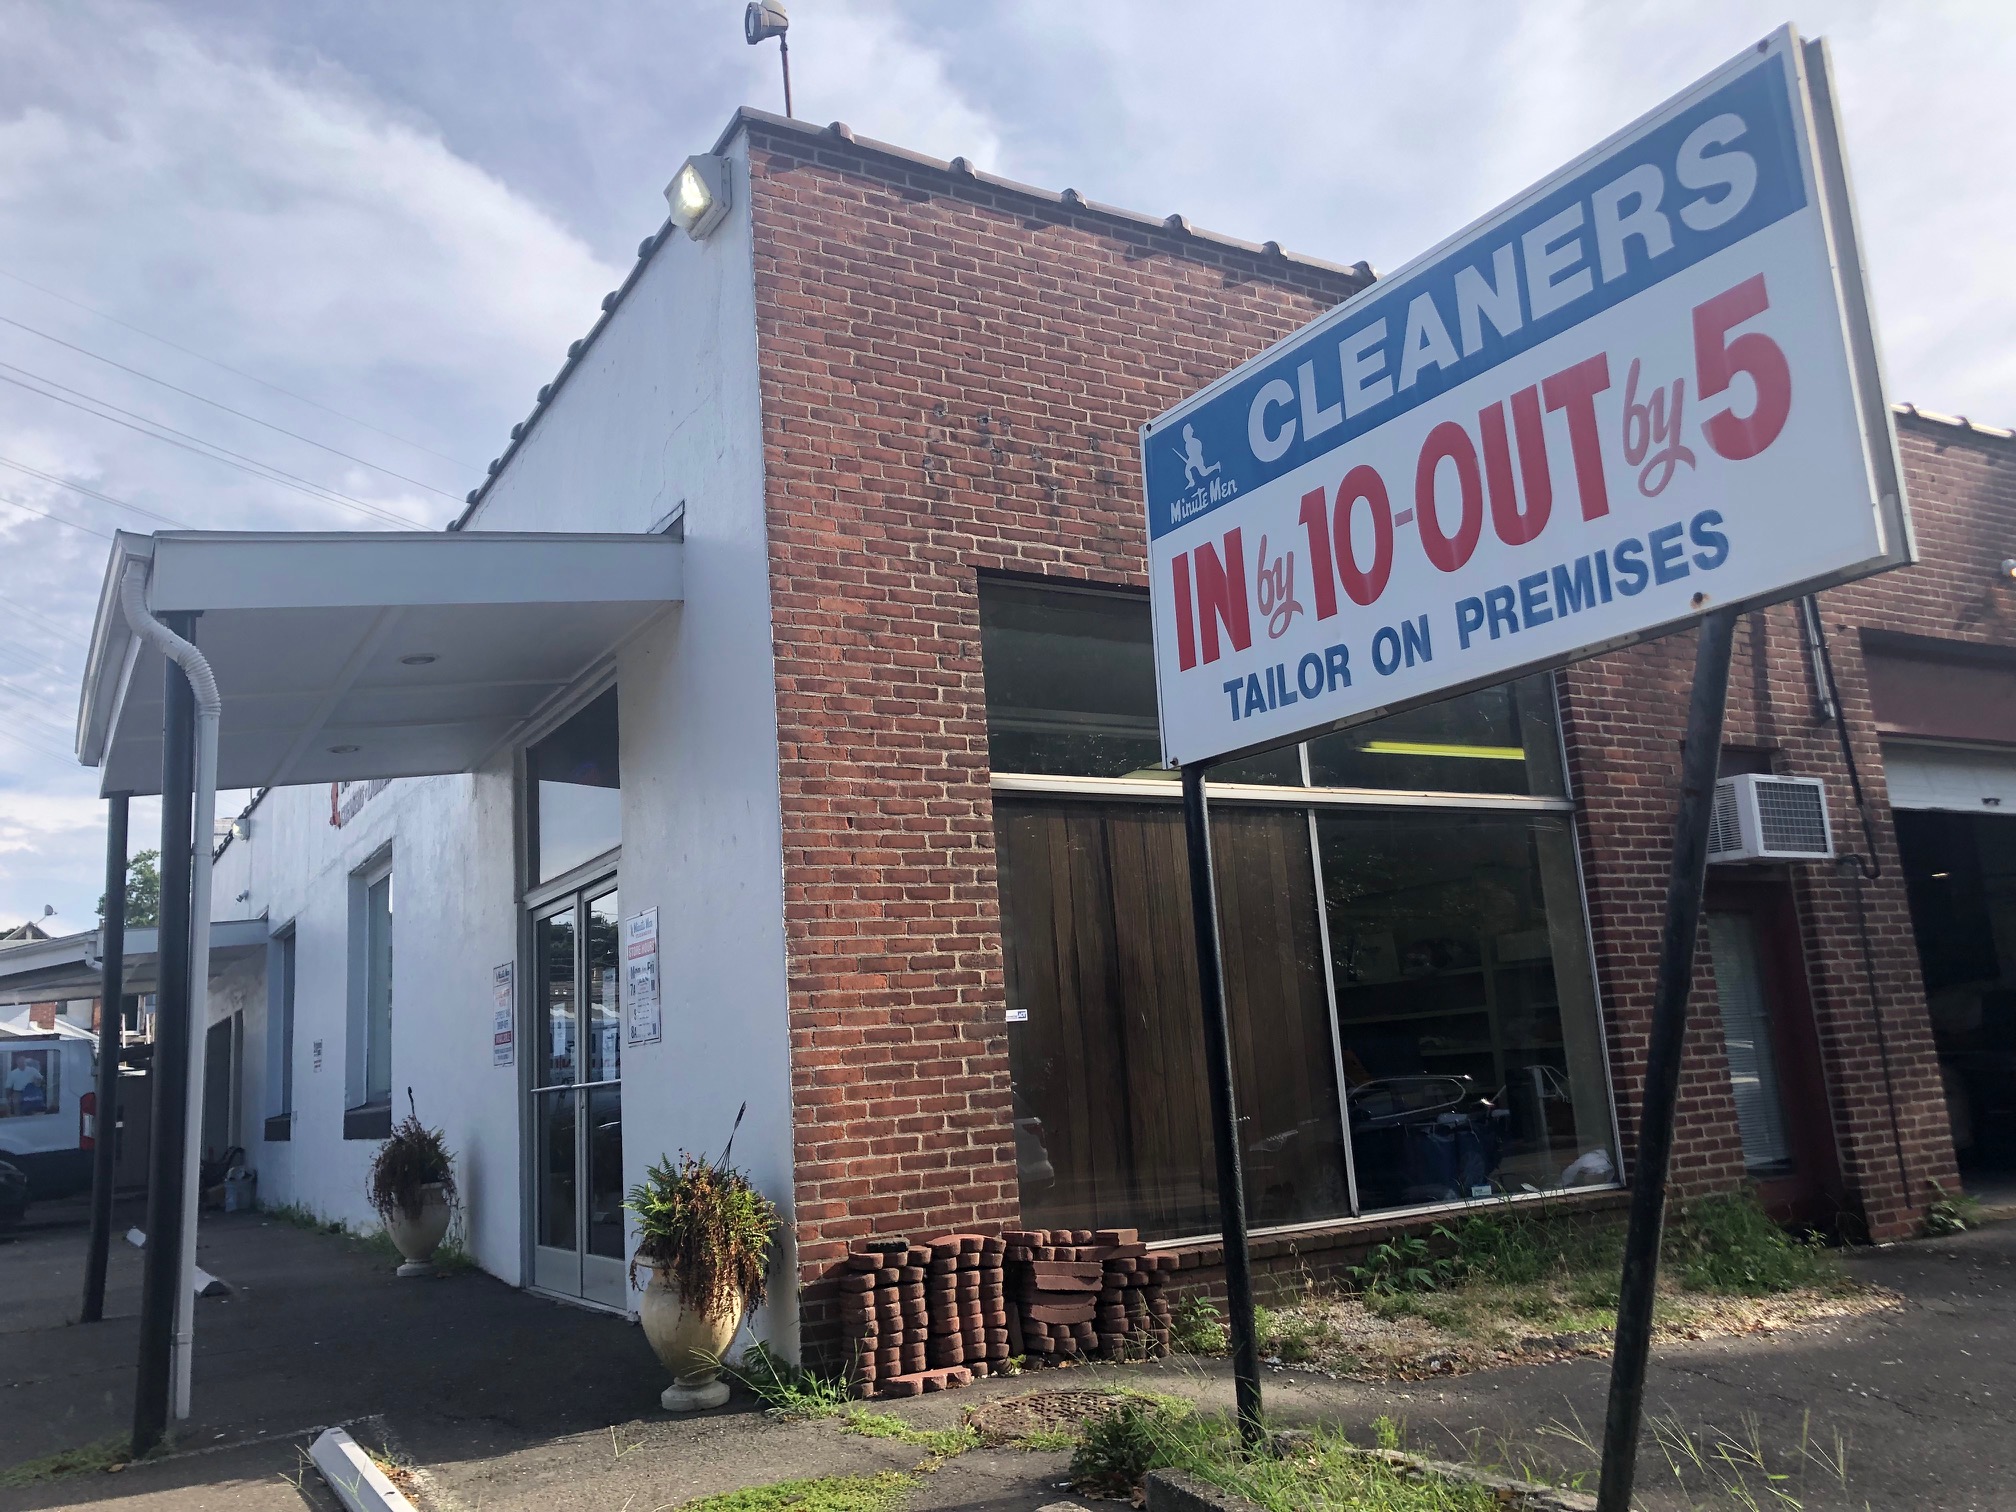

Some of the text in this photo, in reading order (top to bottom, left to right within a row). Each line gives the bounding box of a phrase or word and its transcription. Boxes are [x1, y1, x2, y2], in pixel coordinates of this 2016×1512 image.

[1247, 112, 1758, 463] CLEANERS
[1170, 477, 1238, 524] Minute Men
[1172, 526, 1252, 672] IN
[1257, 534, 1304, 639] by
[1622, 357, 1696, 498] by
[1692, 272, 1792, 461] 5
[1223, 509, 1729, 721] TAILOR ON PREMISES
